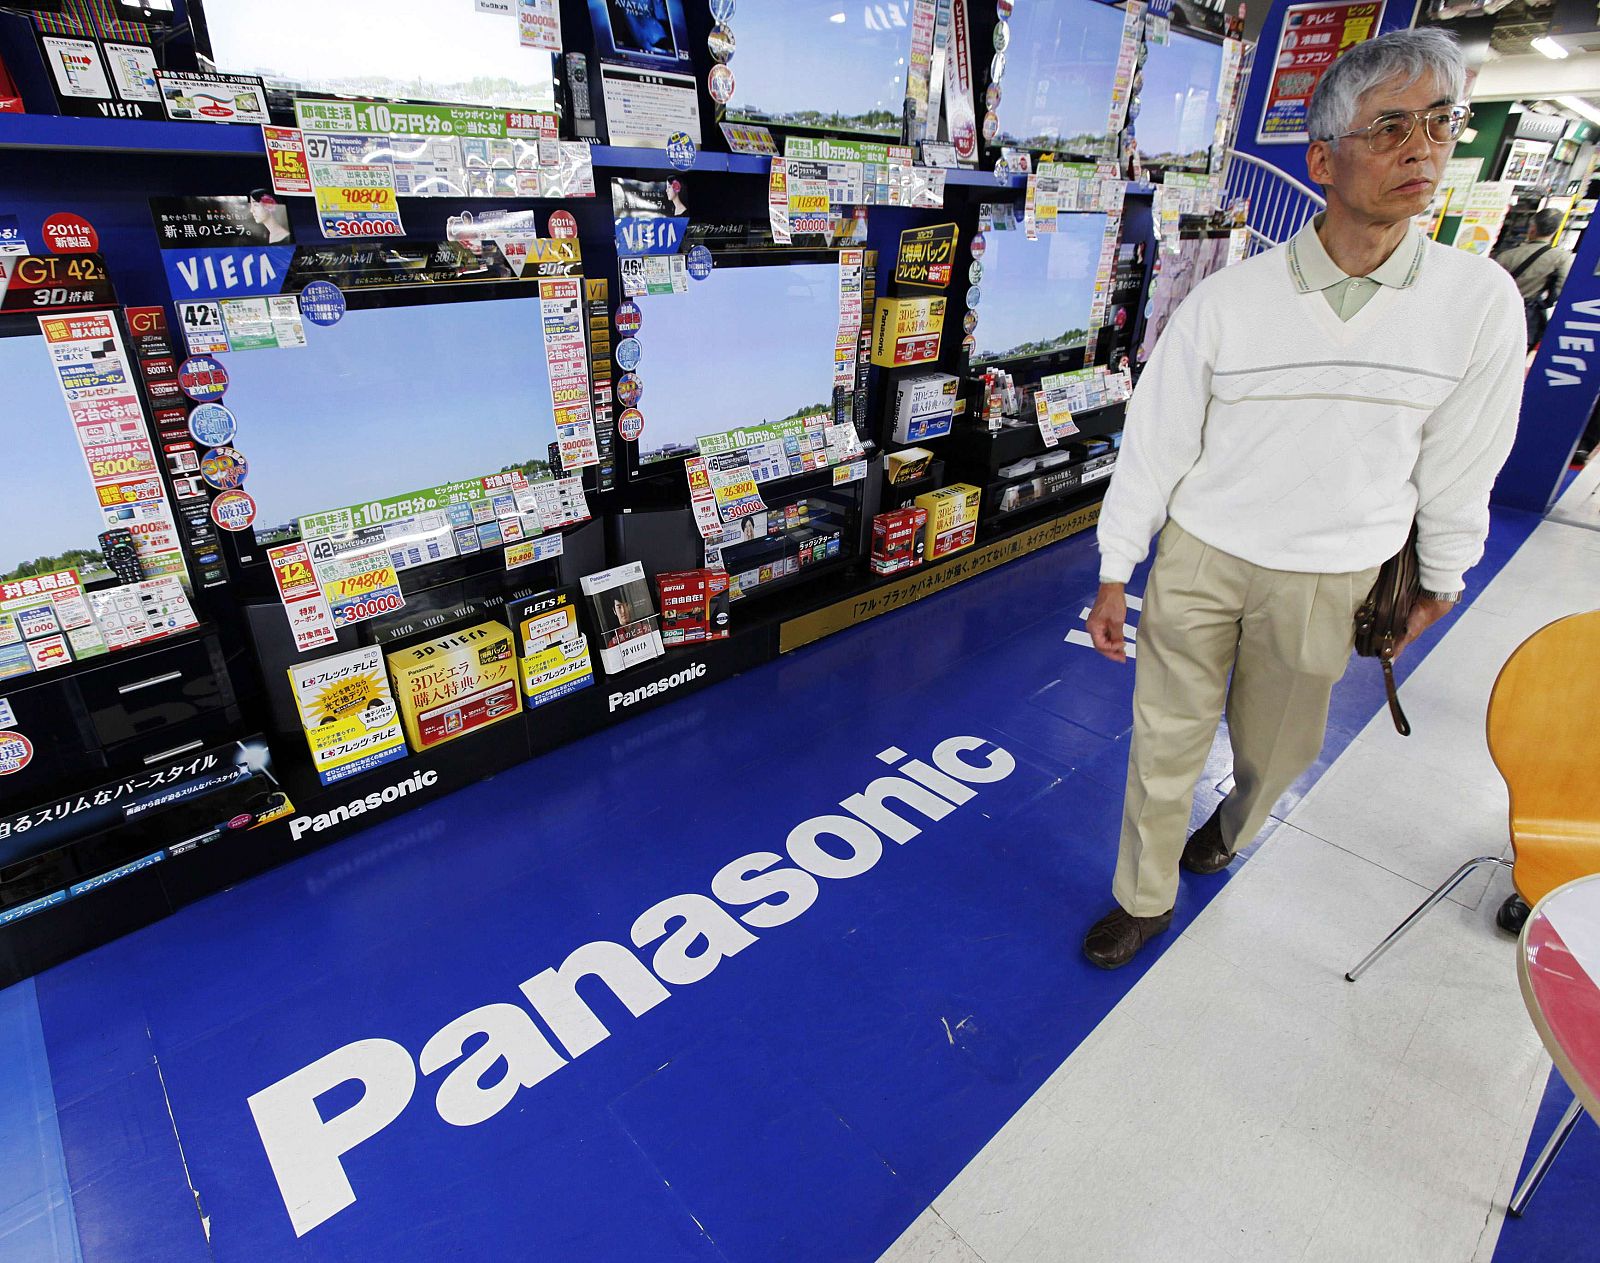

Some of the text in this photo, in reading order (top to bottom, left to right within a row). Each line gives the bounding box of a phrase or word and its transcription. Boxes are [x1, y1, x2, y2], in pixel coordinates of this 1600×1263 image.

[1307, 12, 1336, 25] テレビ
[1295, 52, 1332, 64] エアコン
[98, 103, 143, 118] VIERA
[301, 105, 352, 119] 節電生活
[510, 114, 555, 128] 対象商品
[307, 139, 327, 158] 37
[787, 164, 799, 177] 42
[47, 224, 91, 236] 2011年
[622, 222, 677, 249] VIERA
[54, 236, 91, 248] 新製品
[18, 257, 59, 284] GT
[176, 253, 277, 292] VIERA
[899, 264, 928, 281] プレゼント
[132, 312, 160, 331] GT
[898, 308, 926, 321] 3Dビエラ
[877, 308, 889, 357] Panasonic
[1544, 299, 1600, 387] VIERA
[181, 368, 229, 388] 新製品
[79, 387, 118, 398] プレゼント
[74, 403, 139, 422] 2台でお得
[202, 455, 234, 476] 3D
[708, 458, 719, 471] 46
[485, 472, 522, 489] 対象商品
[314, 542, 333, 560] 42
[280, 562, 312, 584] 12%
[2, 571, 75, 599] 対象商品
[298, 605, 317, 617] 特別
[523, 593, 567, 616] FLET'S 光
[297, 626, 331, 642] 対象商品
[412, 628, 489, 660] 3D VIERA
[407, 664, 435, 677] Panasonic
[410, 661, 470, 693] 3Dビエラ
[542, 659, 587, 683] フレッツ・テレビ
[321, 679, 368, 703] テレビを買うなら
[413, 664, 508, 710] 購入特典パック
[608, 662, 707, 713] Panasonic
[336, 727, 397, 757] フレッツ・テレビ
[289, 767, 438, 841] Panasonic
[246, 735, 1016, 1238] Panasonic
